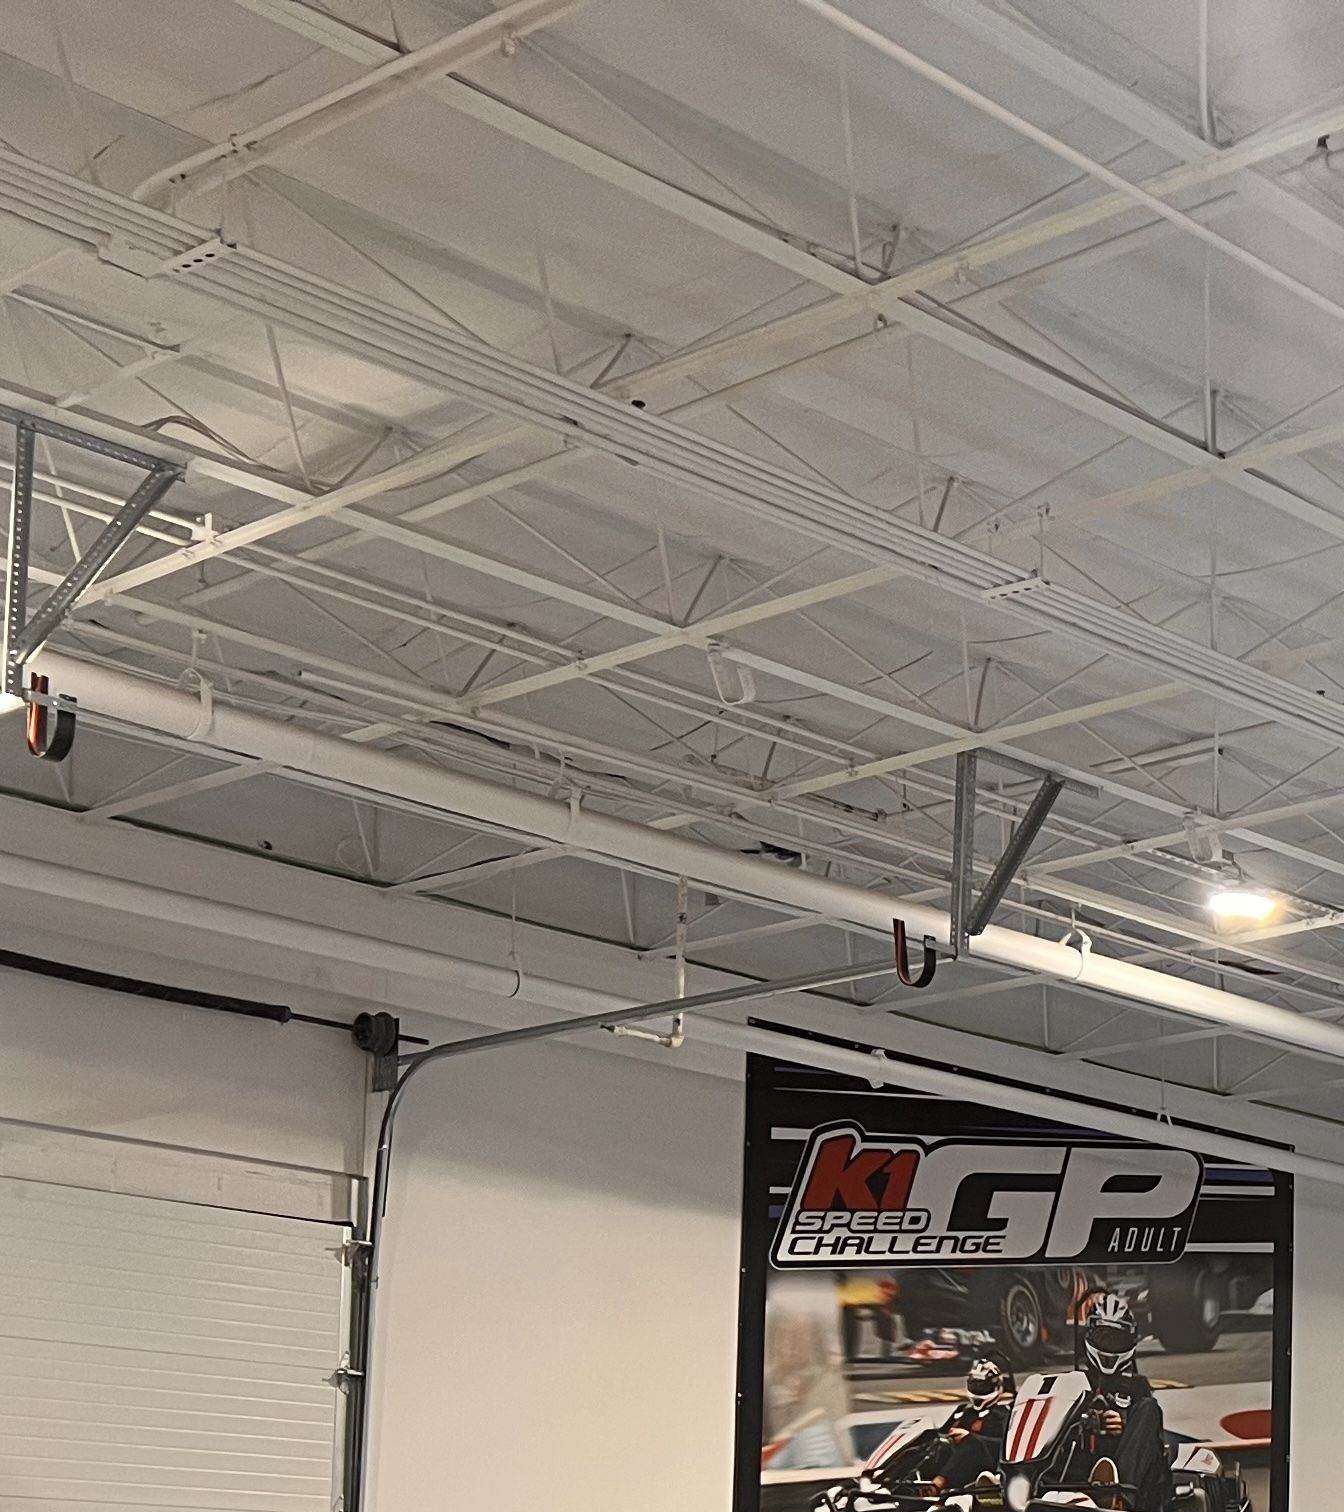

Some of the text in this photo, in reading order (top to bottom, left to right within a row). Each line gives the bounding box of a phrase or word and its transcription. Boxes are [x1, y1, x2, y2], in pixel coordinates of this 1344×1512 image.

[803, 1134, 920, 1212] K1
[906, 1144, 1200, 1259] GP
[795, 1212, 929, 1232] SPEED
[787, 1234, 1006, 1255] CHALLENGE
[1107, 1226, 1183, 1253] ADULT
